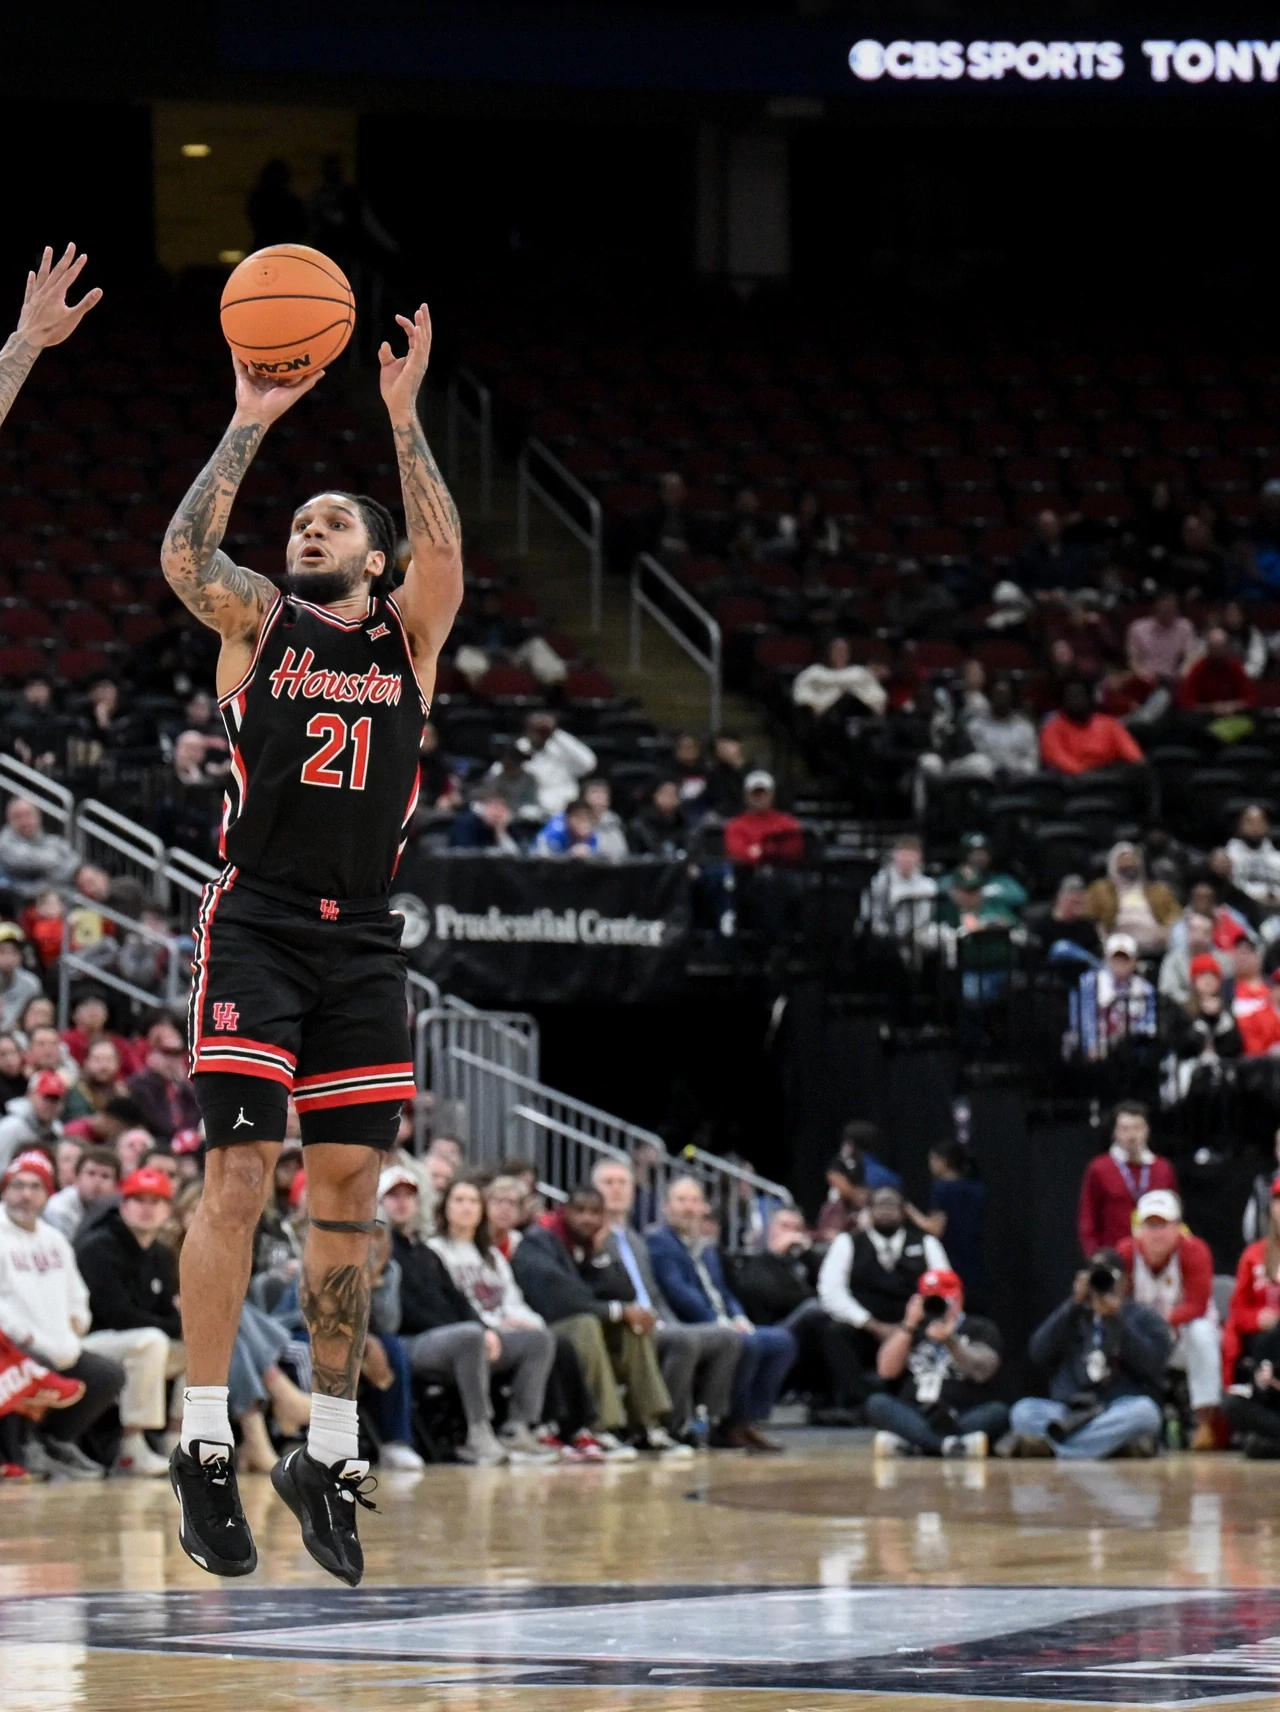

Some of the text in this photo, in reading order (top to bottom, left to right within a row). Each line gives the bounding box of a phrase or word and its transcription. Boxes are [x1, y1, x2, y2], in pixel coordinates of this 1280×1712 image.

[885, 39, 1280, 83] CBS SPORTS TONY
[269, 646, 402, 706] Houston
[301, 712, 372, 790] 21
[435, 904, 666, 947] Prudential Center
